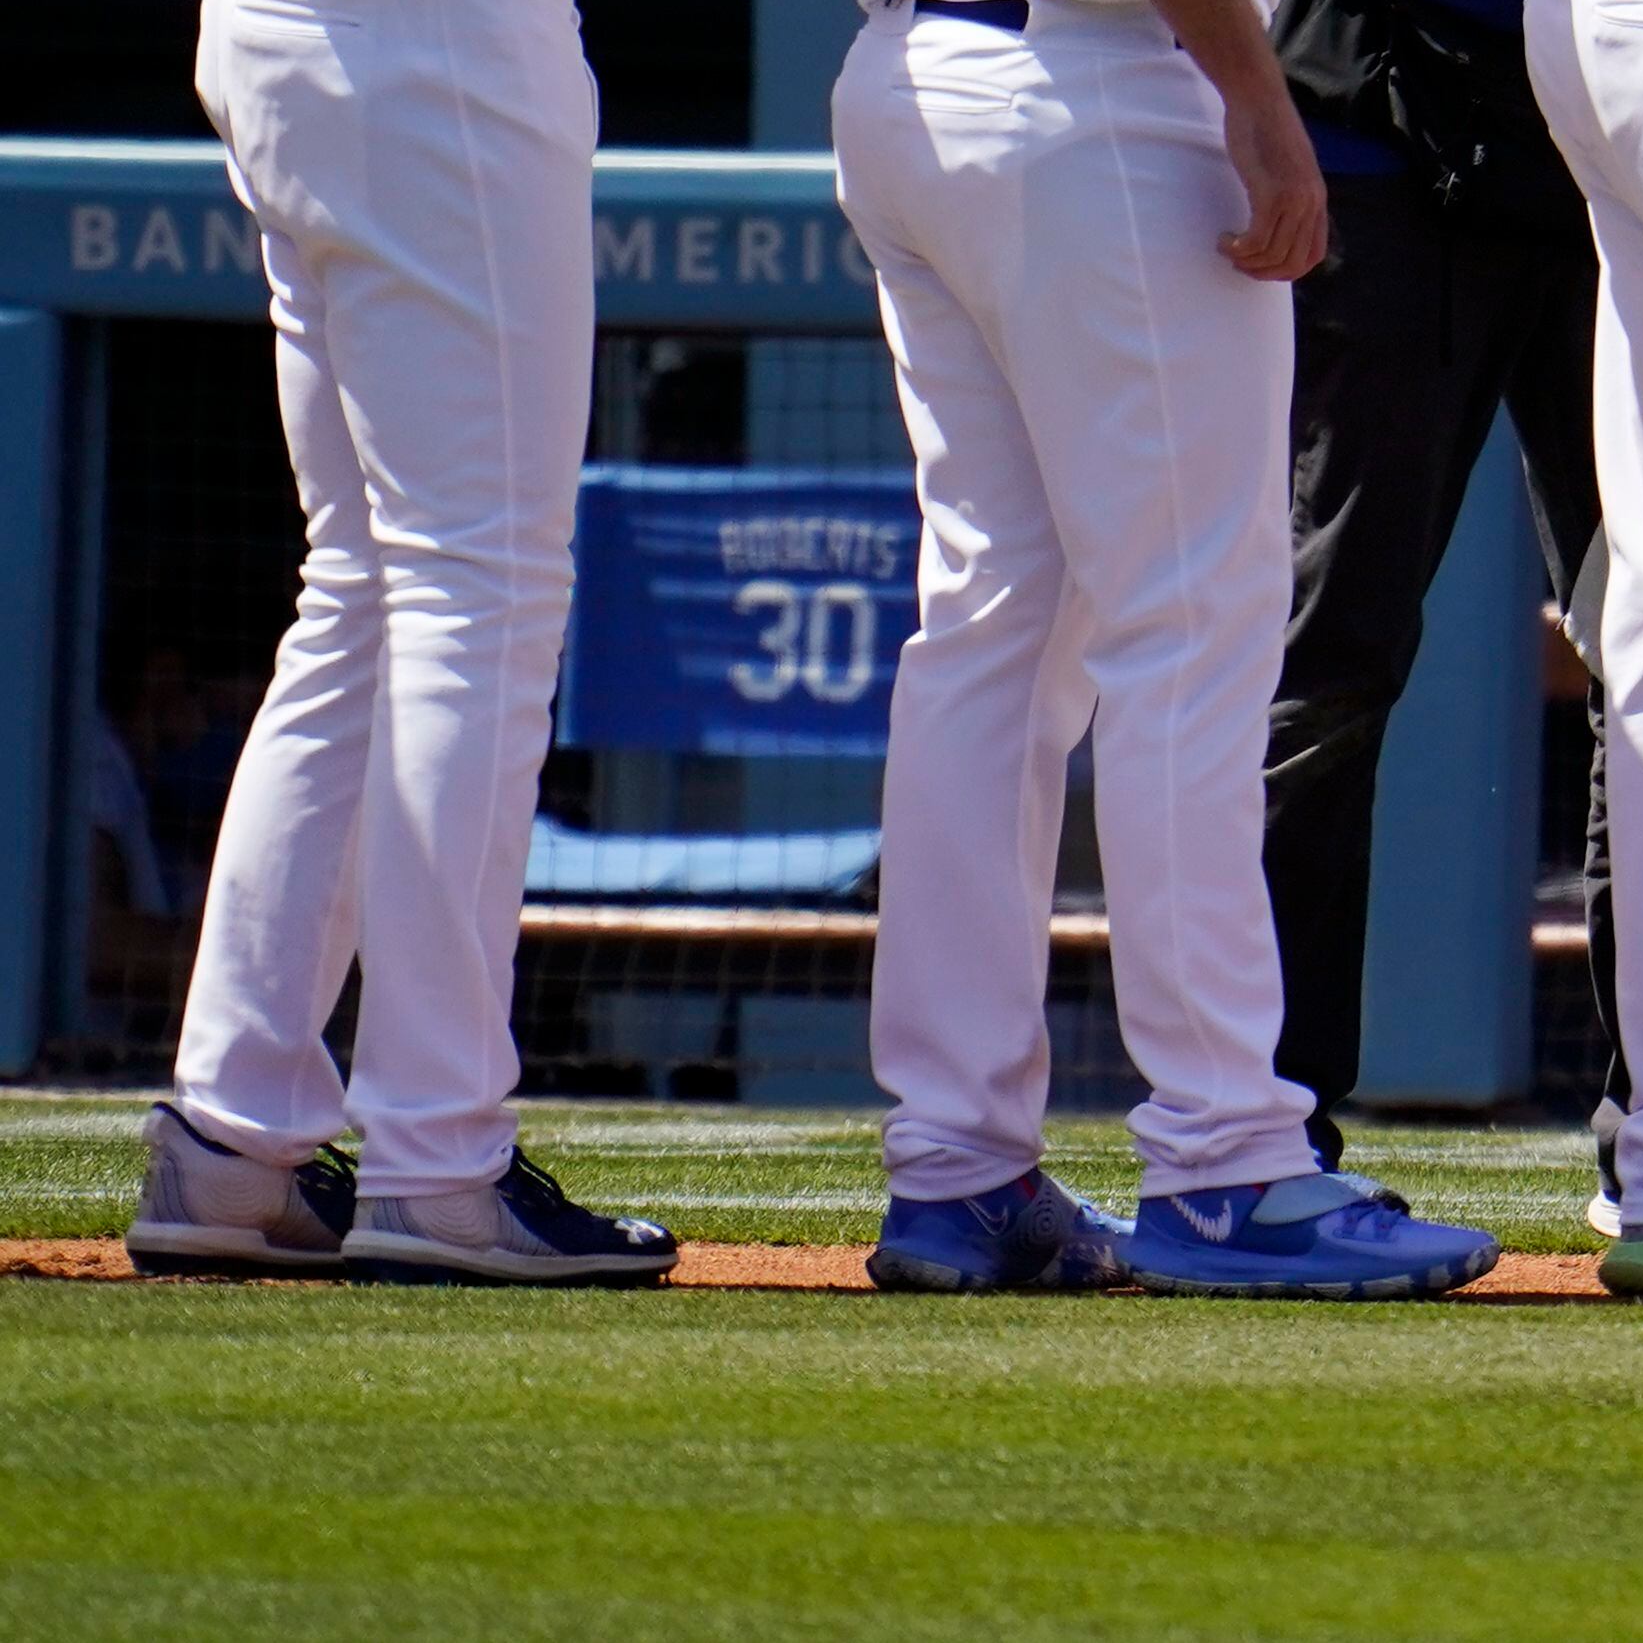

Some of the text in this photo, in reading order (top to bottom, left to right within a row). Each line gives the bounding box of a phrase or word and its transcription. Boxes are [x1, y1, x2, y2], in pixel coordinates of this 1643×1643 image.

[70, 205, 262, 274] BAN
[593, 215, 877, 284] MERIC
[731, 579, 879, 704] 30
